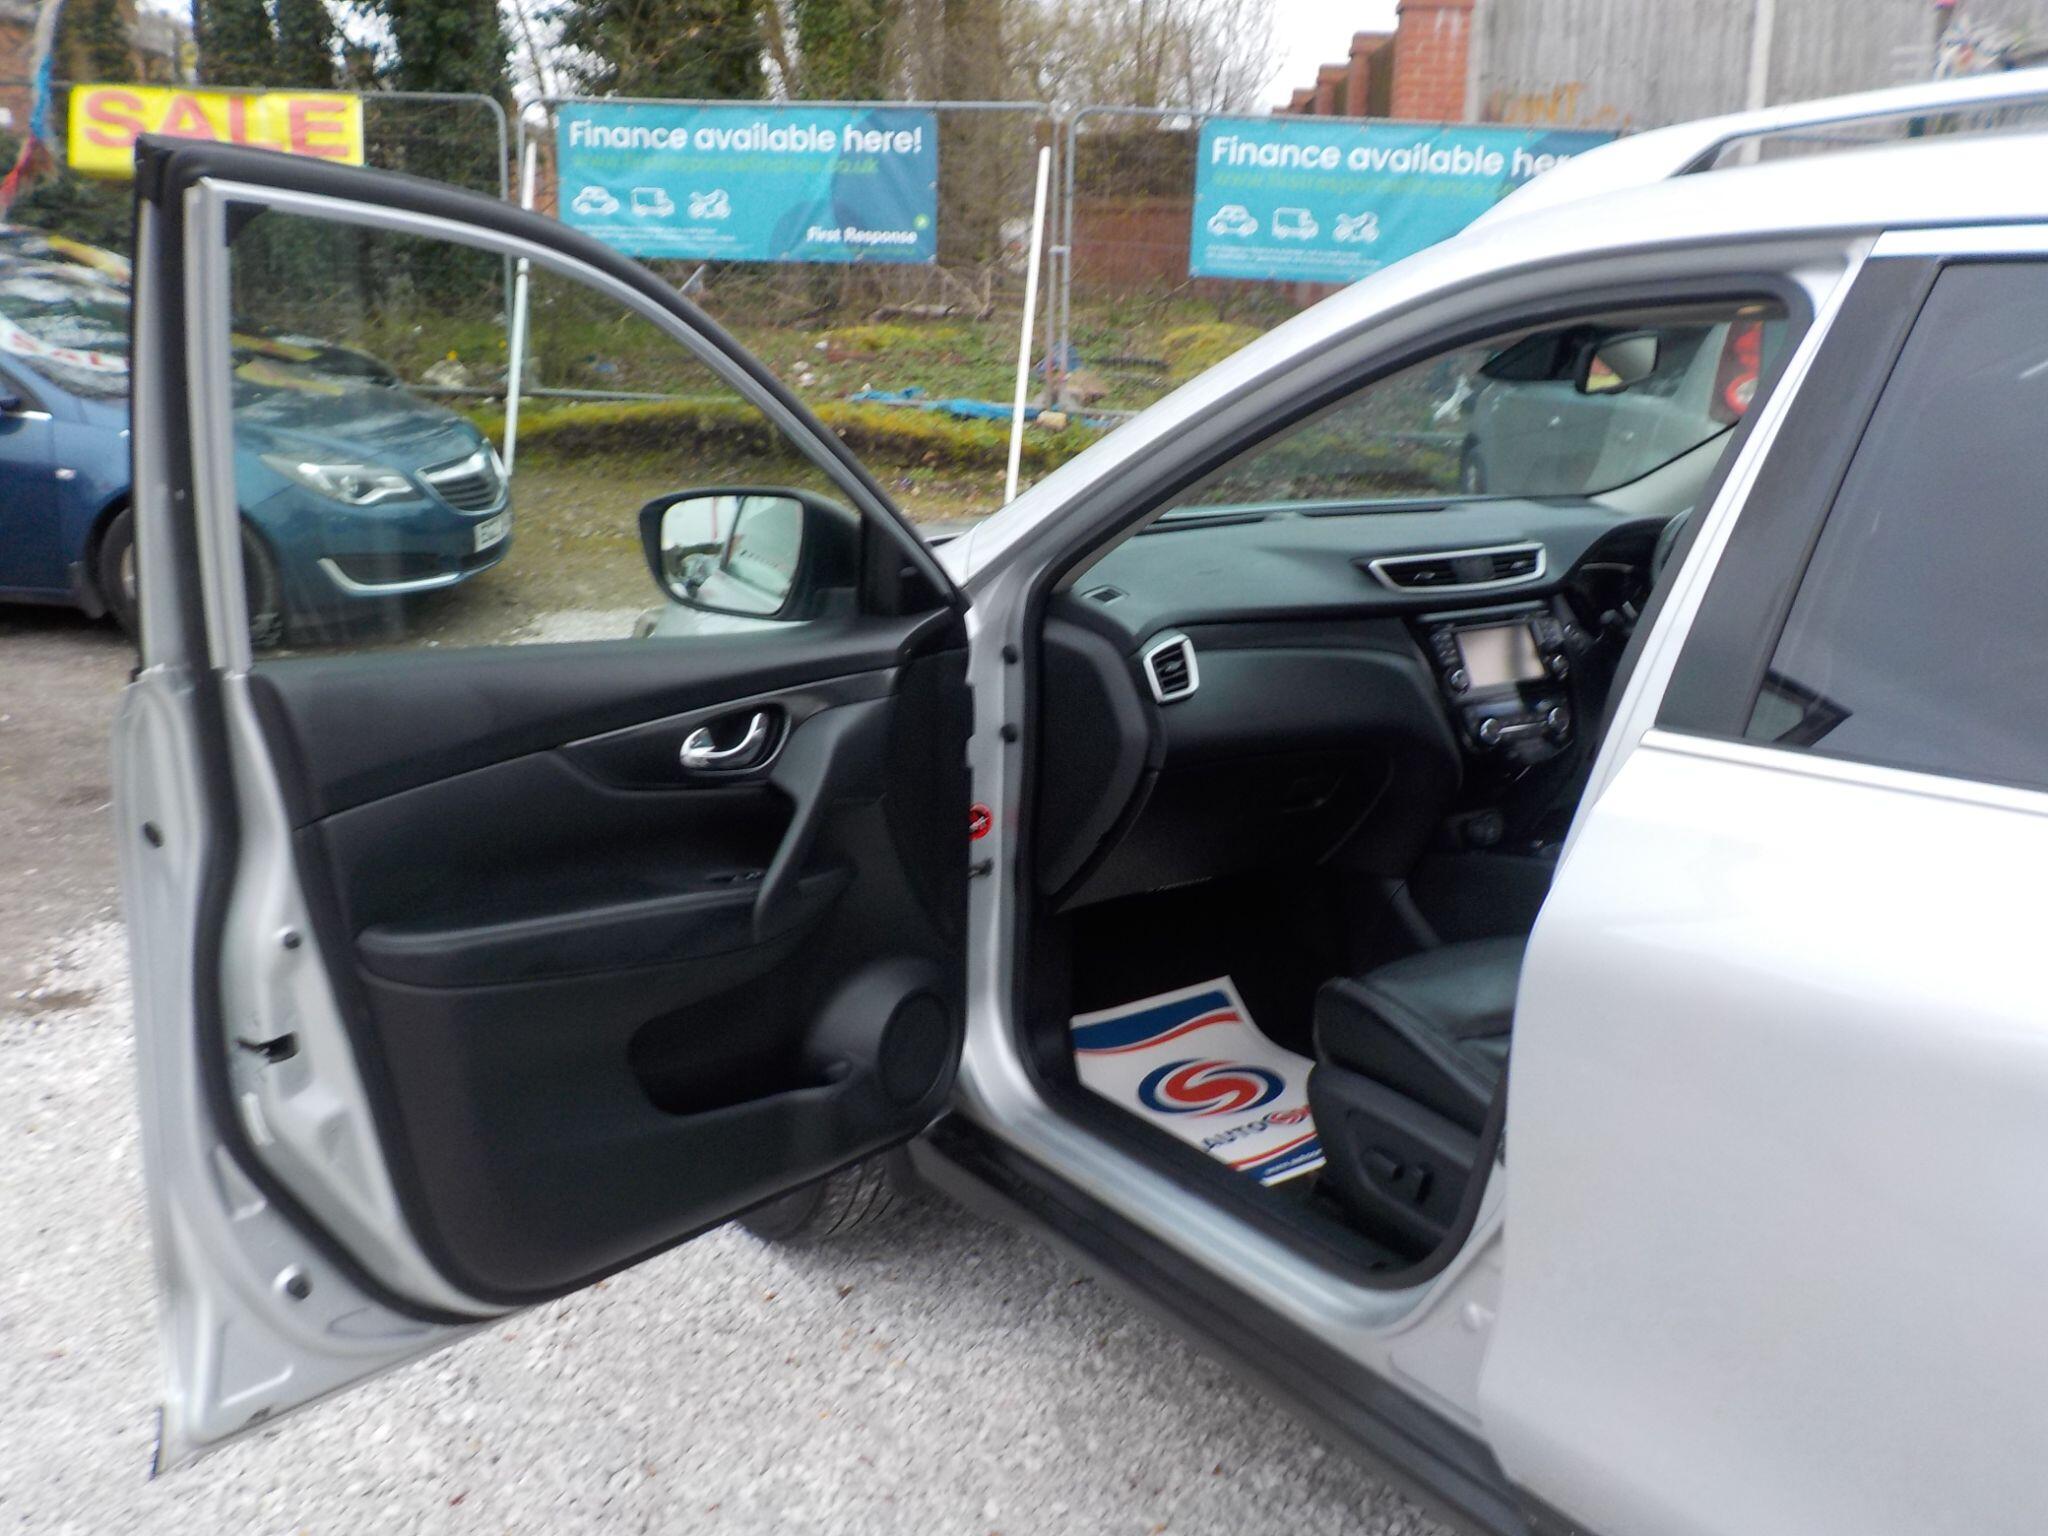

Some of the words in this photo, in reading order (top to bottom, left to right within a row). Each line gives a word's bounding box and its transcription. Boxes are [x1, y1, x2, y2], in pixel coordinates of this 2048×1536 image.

[84, 90, 349, 157] SALE
[569, 119, 687, 151] Finance
[694, 122, 837, 153] available
[843, 124, 924, 154] here!
[1211, 135, 1339, 170] Finance
[1348, 142, 1504, 177] available
[806, 225, 842, 243] First
[843, 226, 918, 246] Response
